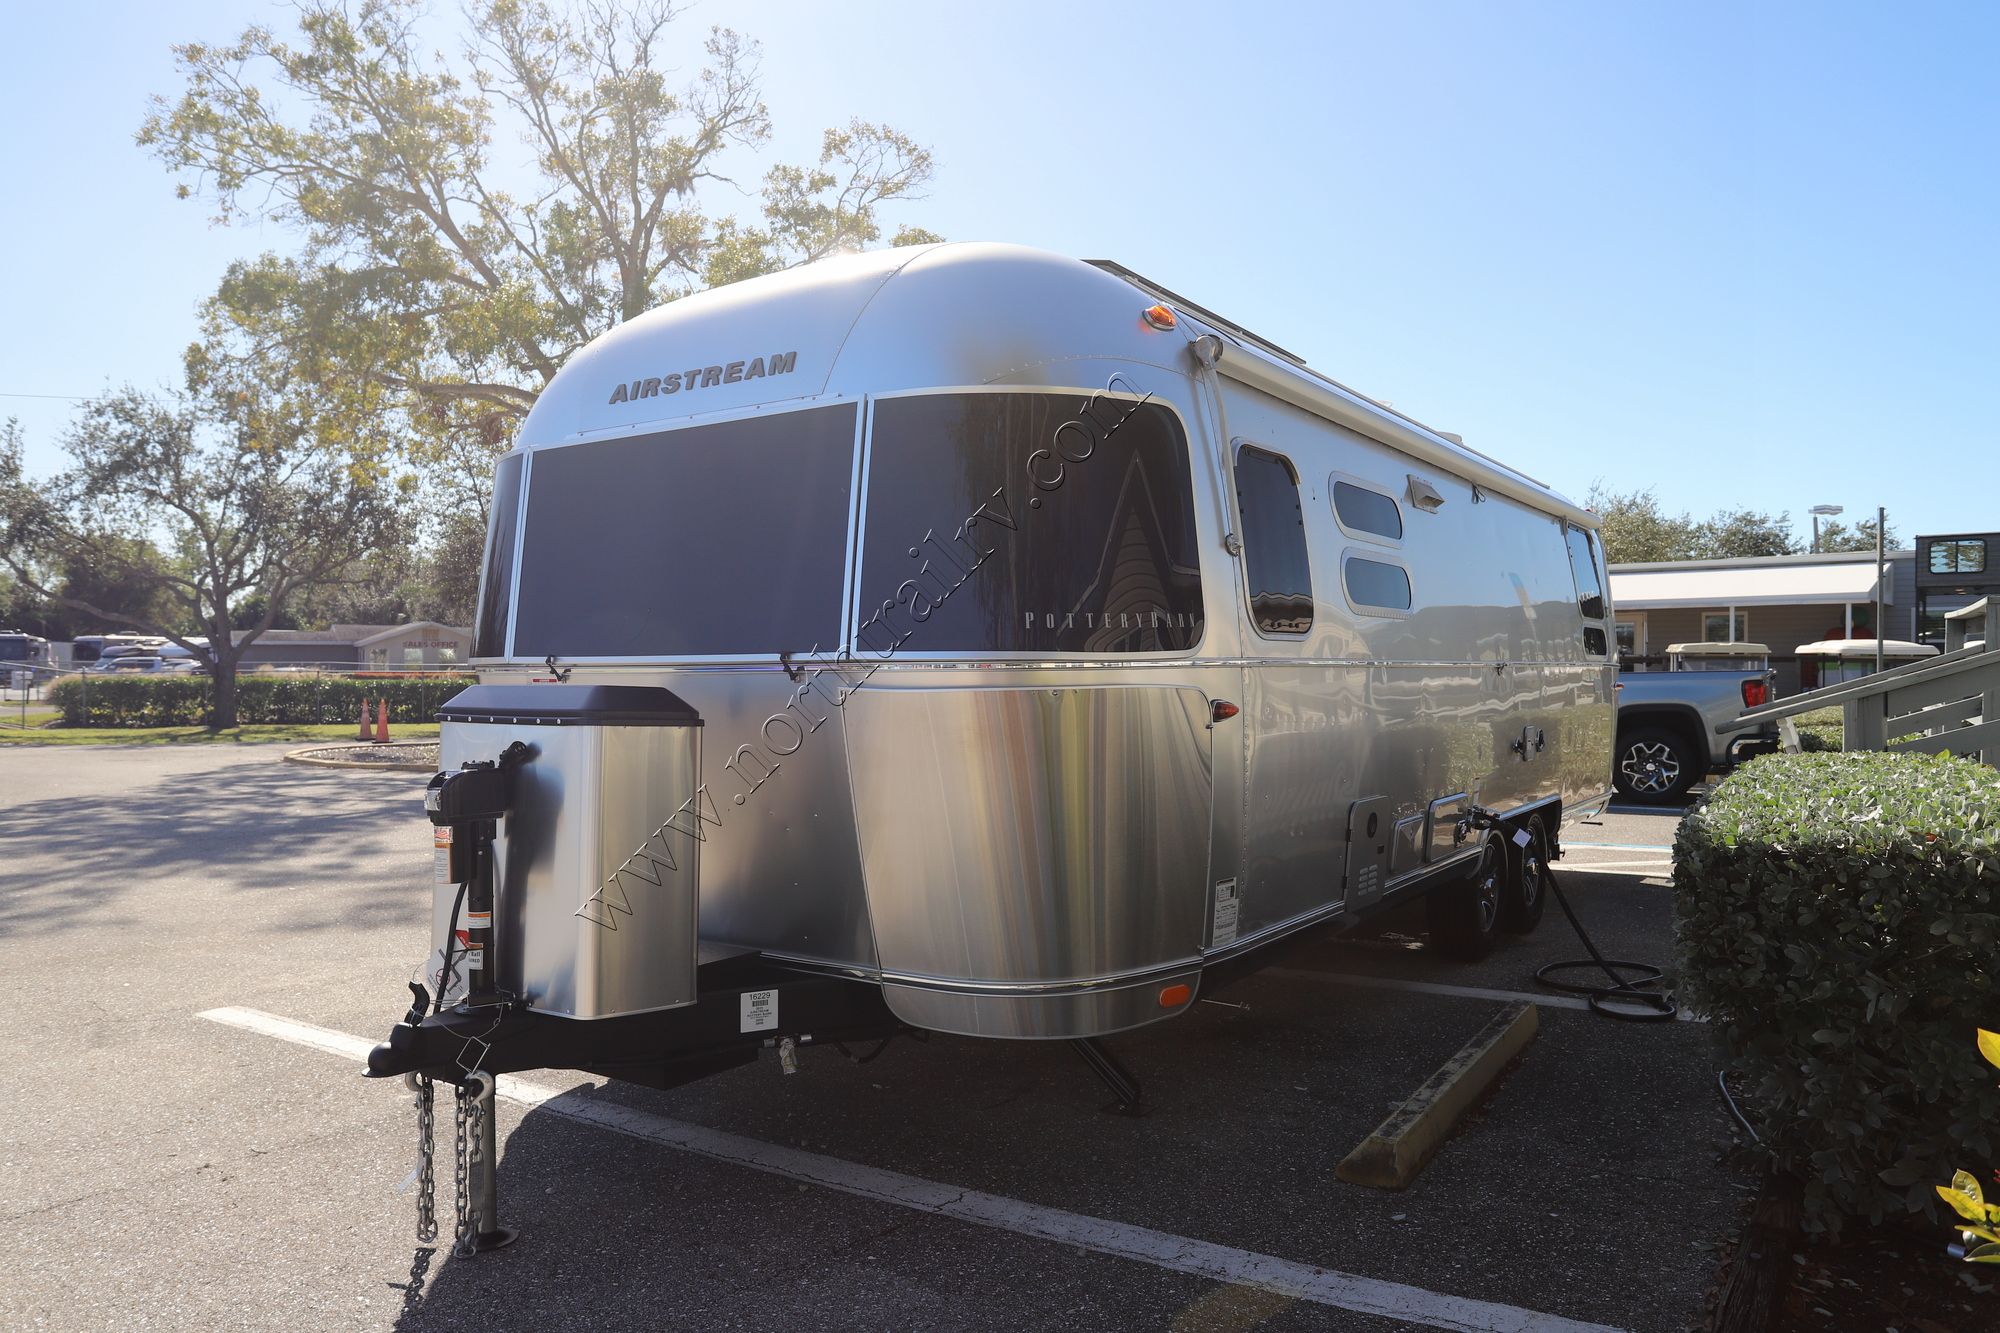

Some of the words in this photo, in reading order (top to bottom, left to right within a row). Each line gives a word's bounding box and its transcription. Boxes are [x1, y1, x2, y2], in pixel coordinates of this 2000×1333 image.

[609, 351, 797, 404] AIRSTREAM
[430, 640, 458, 648] OFFICE
[750, 992, 771, 1000] 16229
